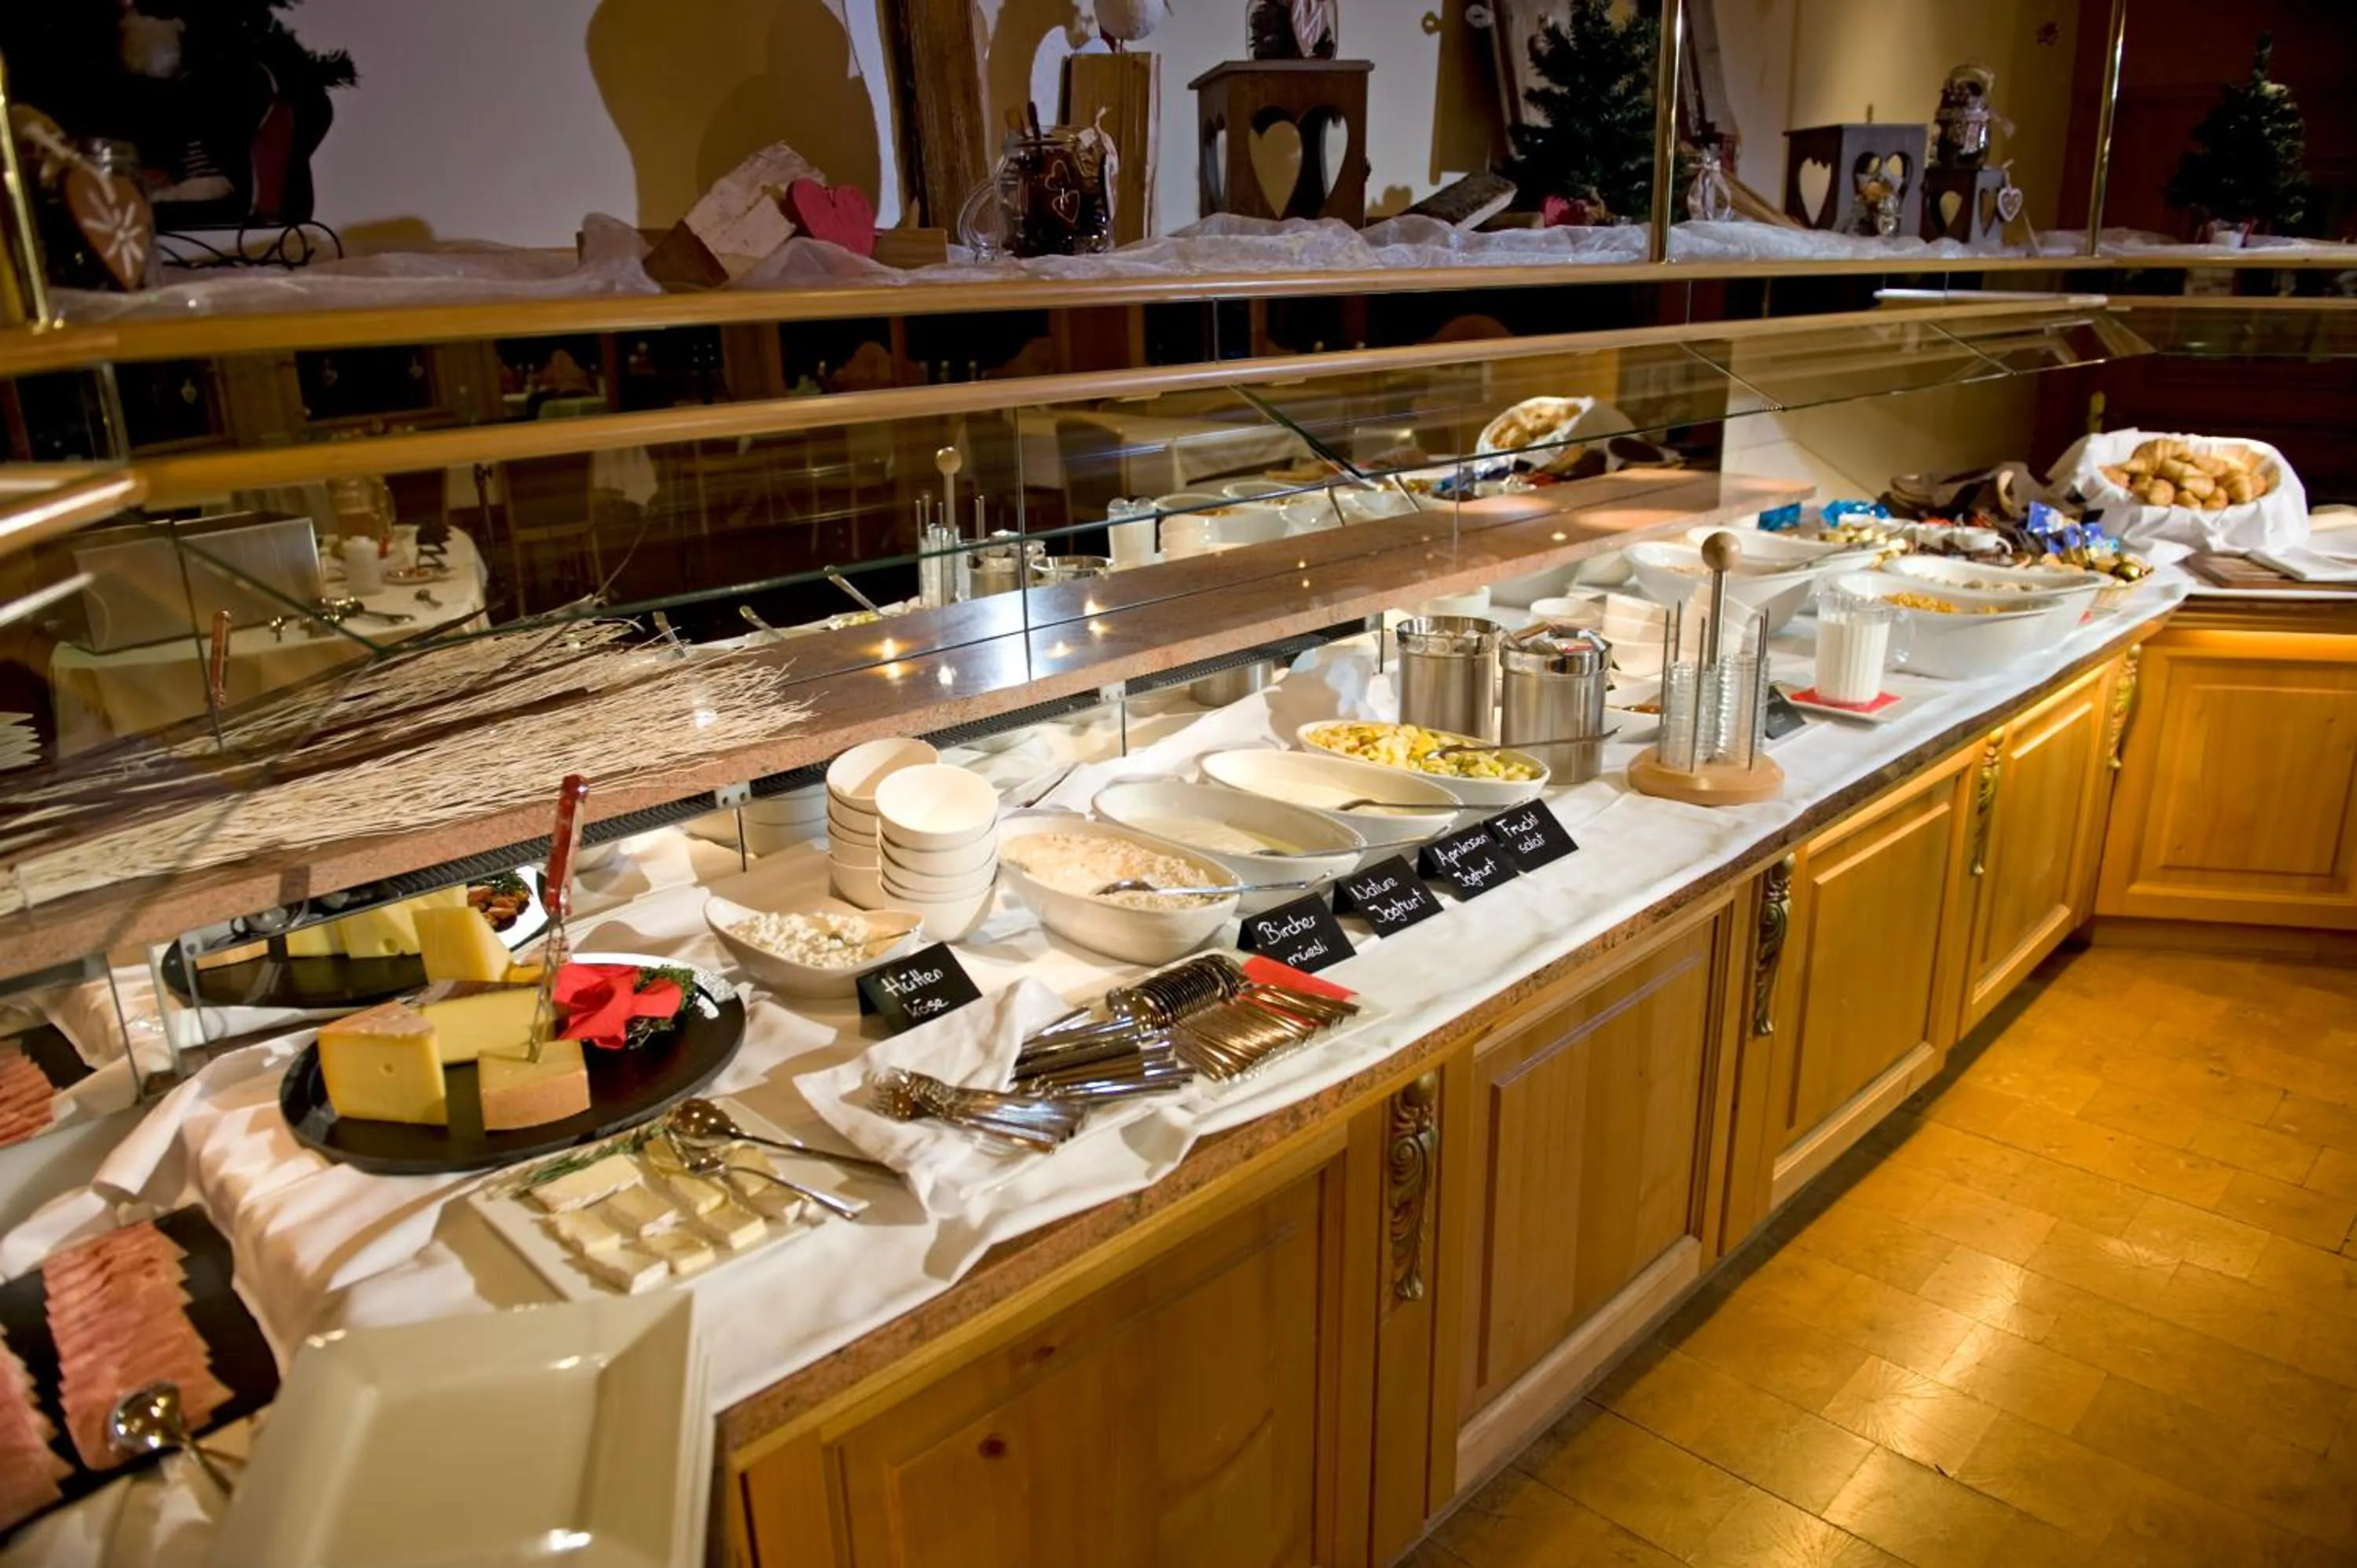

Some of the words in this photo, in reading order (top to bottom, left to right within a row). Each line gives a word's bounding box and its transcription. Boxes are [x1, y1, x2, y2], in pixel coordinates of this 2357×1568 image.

[1495, 811, 1540, 837] Frucht
[1434, 833, 1490, 869] Aprikosen
[1452, 855, 1497, 888] Joghurt
[1349, 877, 1399, 901] Nature
[1367, 887, 1427, 923] Joghurt
[1256, 914, 1318, 945] Bircher
[880, 968, 944, 998] Hütten
